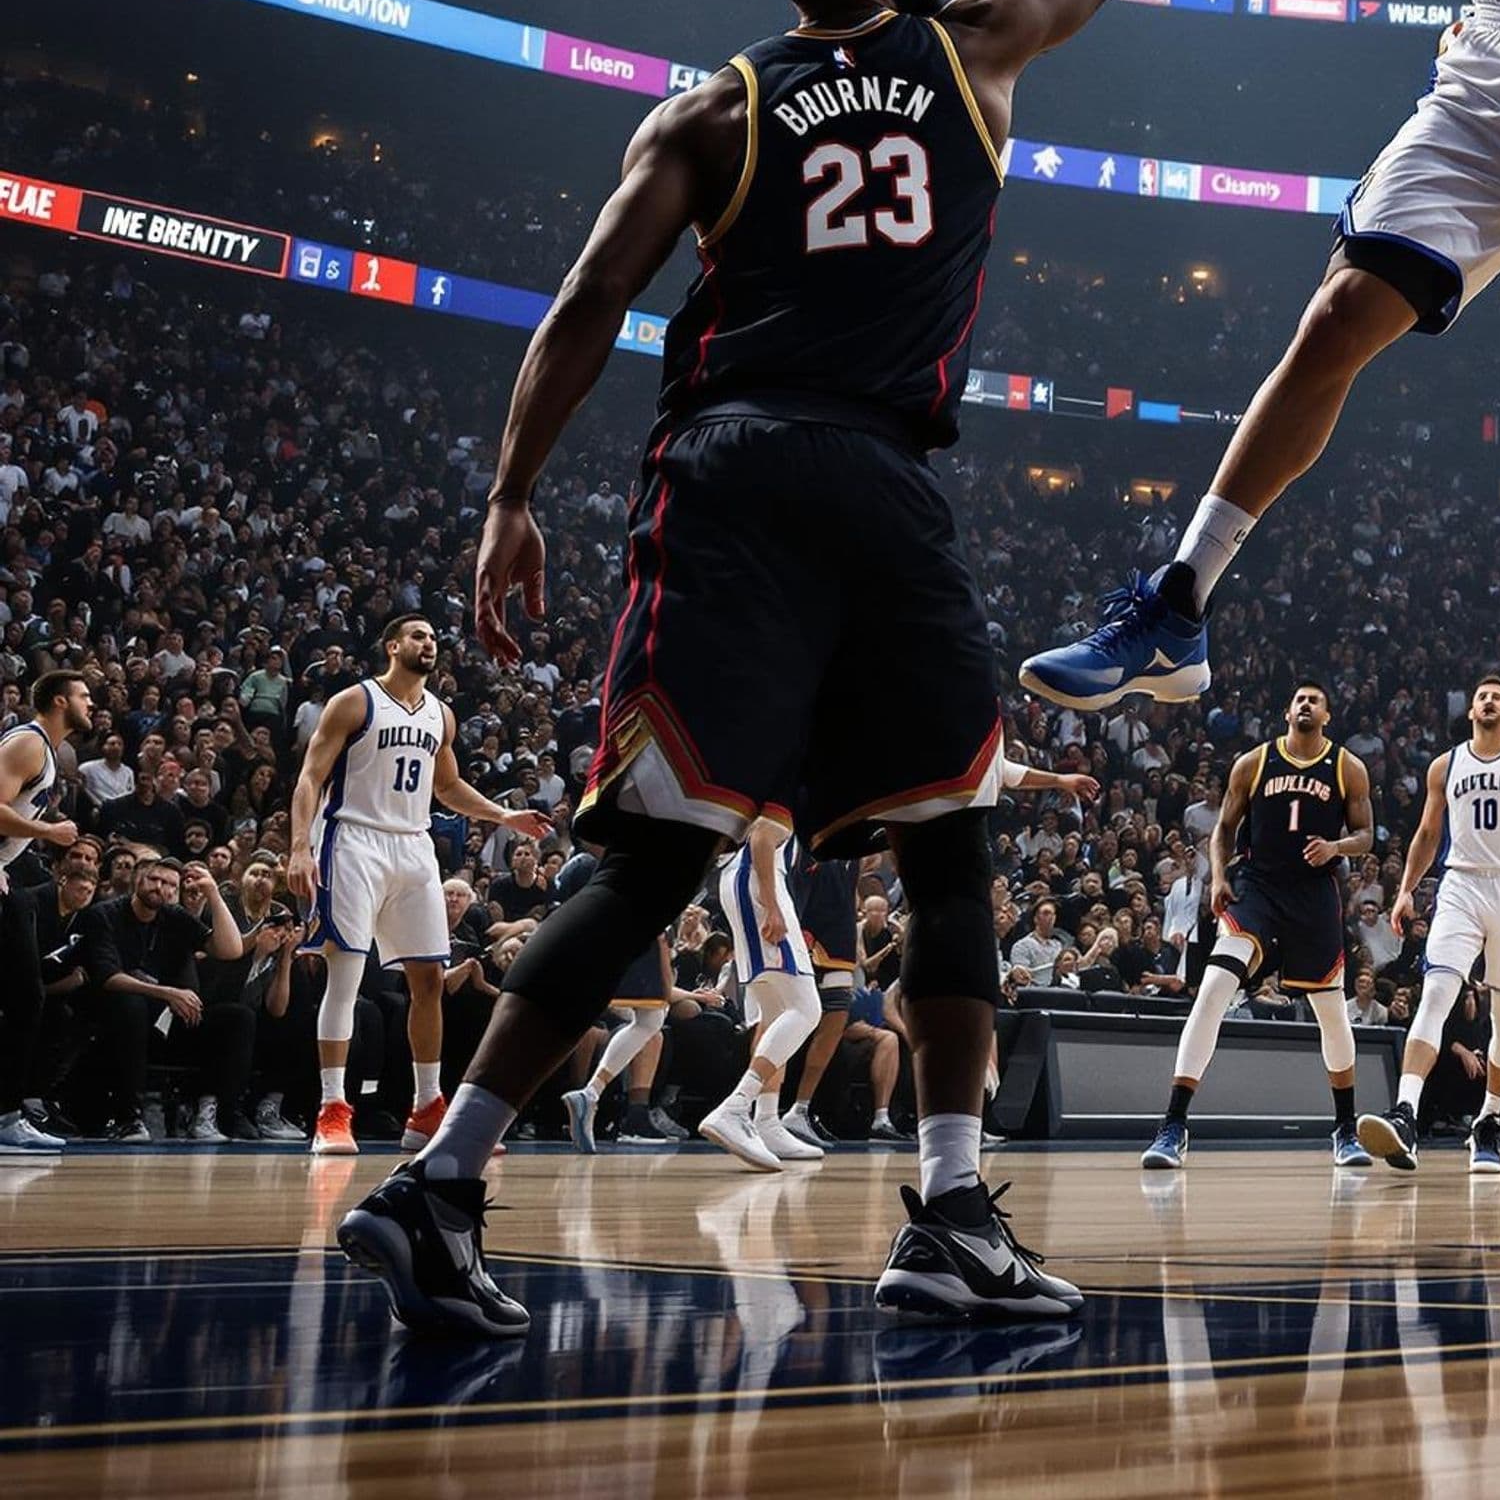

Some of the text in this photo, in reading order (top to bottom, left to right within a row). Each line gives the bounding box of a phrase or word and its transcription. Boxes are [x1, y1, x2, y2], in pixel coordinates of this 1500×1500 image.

[803, 133, 933, 253] 23
[102, 206, 147, 241] INE
[1289, 799, 1300, 832] 1
[1472, 797, 1498, 831] 10
